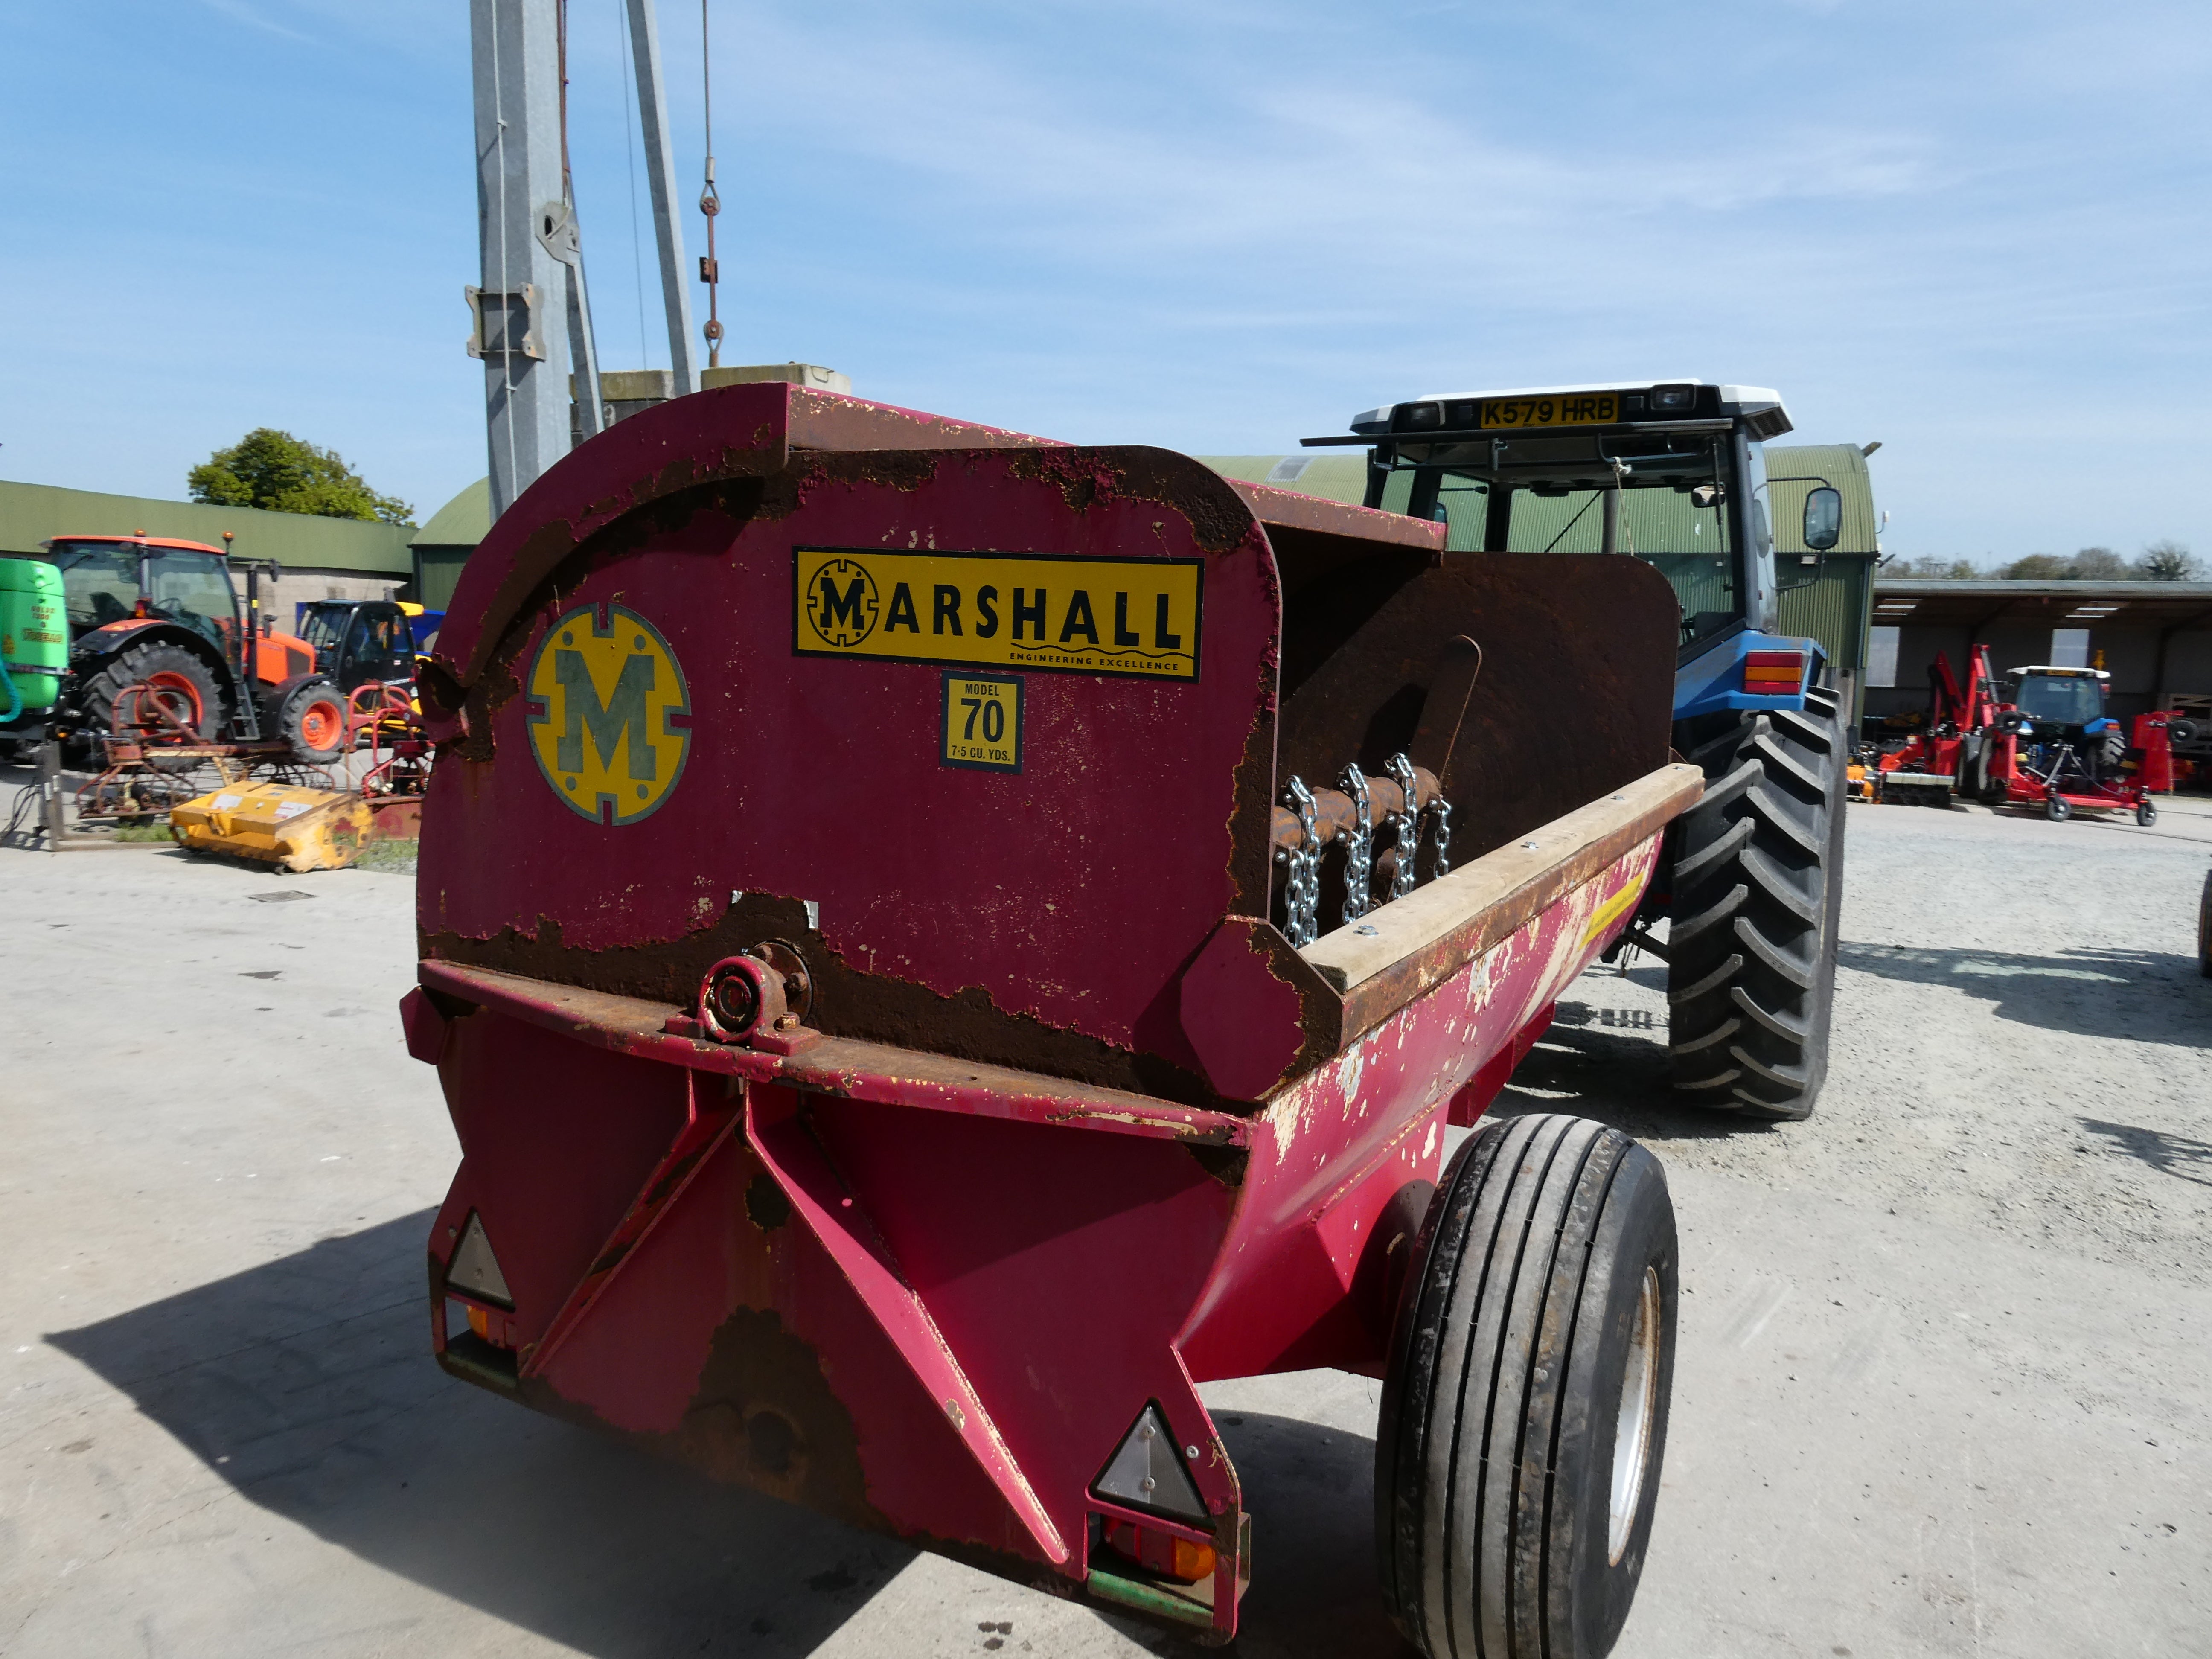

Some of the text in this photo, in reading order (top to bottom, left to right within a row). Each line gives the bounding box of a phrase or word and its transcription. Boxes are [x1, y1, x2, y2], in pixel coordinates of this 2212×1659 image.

[1484, 397, 1614, 425] K579 HRB
[820, 577, 1181, 650] MARSHALL
[1010, 652, 1179, 671] ENGINEERING EXCELLENCE
[965, 683, 999, 696] MODEL
[555, 649, 657, 782] M
[961, 698, 1004, 742] 70
[970, 747, 985, 759] CU.
[988, 749, 1010, 762] YDS.
